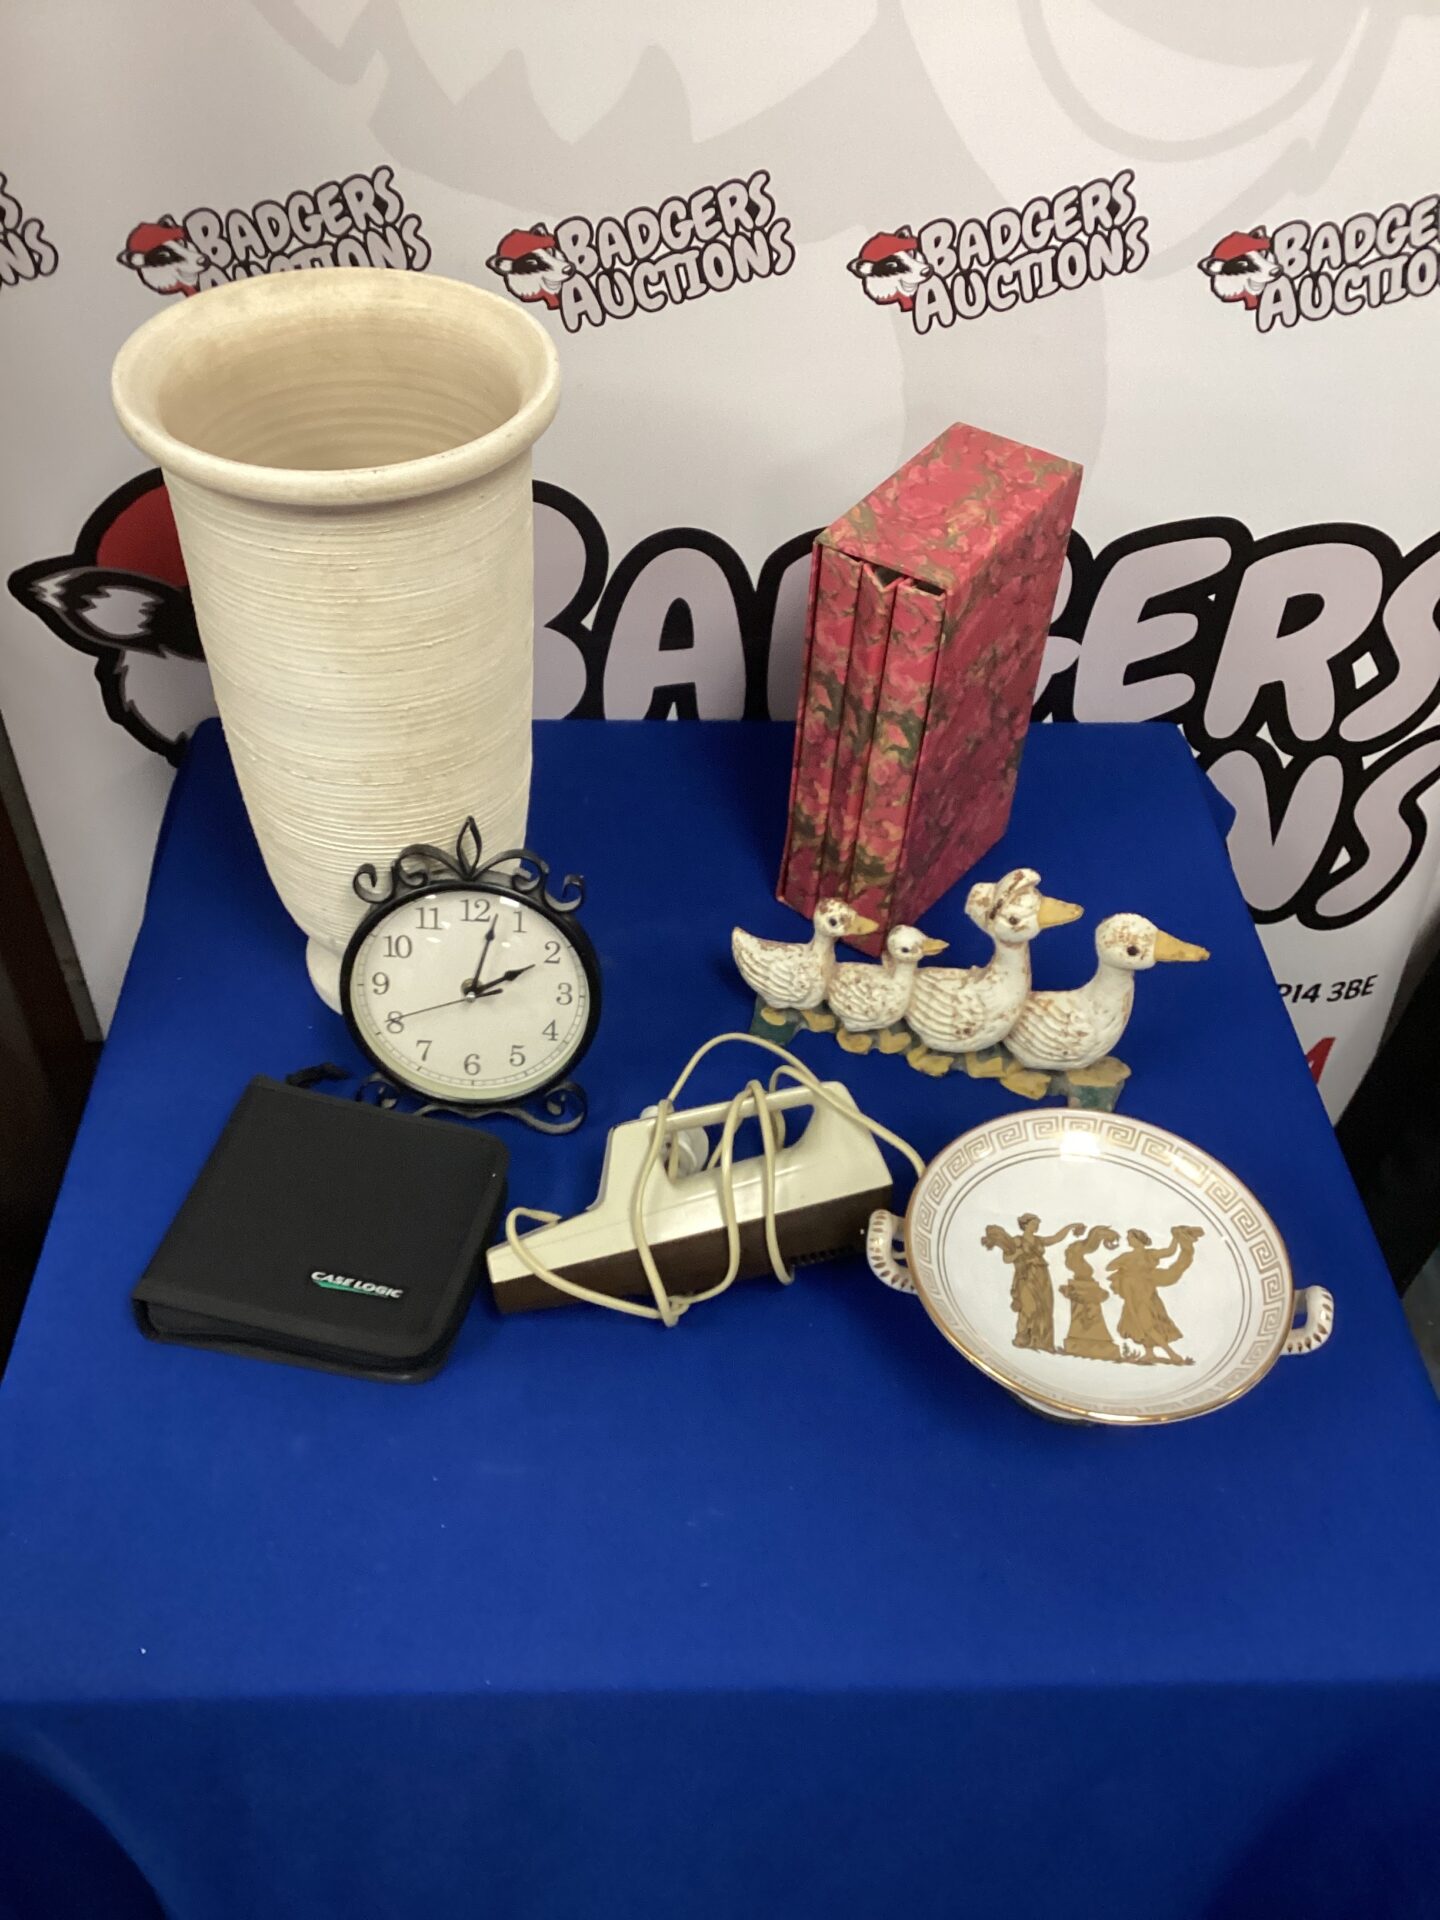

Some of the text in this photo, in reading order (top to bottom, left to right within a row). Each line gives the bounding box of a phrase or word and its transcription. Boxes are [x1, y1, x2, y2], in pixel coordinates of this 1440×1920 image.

[183, 165, 404, 268] BADGERS
[555, 169, 775, 278] BADGERS
[918, 169, 1136, 278] BADGERS
[1272, 194, 1440, 279] BADGE
[198, 213, 431, 291] AONS
[559, 217, 795, 333] AUCTIONS
[912, 216, 1149, 335] AUCTIONS
[1255, 245, 1440, 333] AUCTIO
[532, 479, 1440, 757] BAERS
[415, 907, 442, 930] 11
[460, 899, 491, 923] 12
[512, 911, 526, 933] 1
[383, 935, 413, 958] 10
[544, 941, 561, 964] 2
[372, 972, 389, 995] 9
[556, 983, 573, 1005] 3
[1326, 974, 1378, 1002] 3BE
[386, 1010, 404, 1033] 8
[542, 1020, 558, 1041] 4
[416, 1040, 432, 1061] 7
[509, 1045, 525, 1066] 5
[464, 1054, 481, 1075] 6
[311, 1271, 404, 1299] CASE LOGIC
